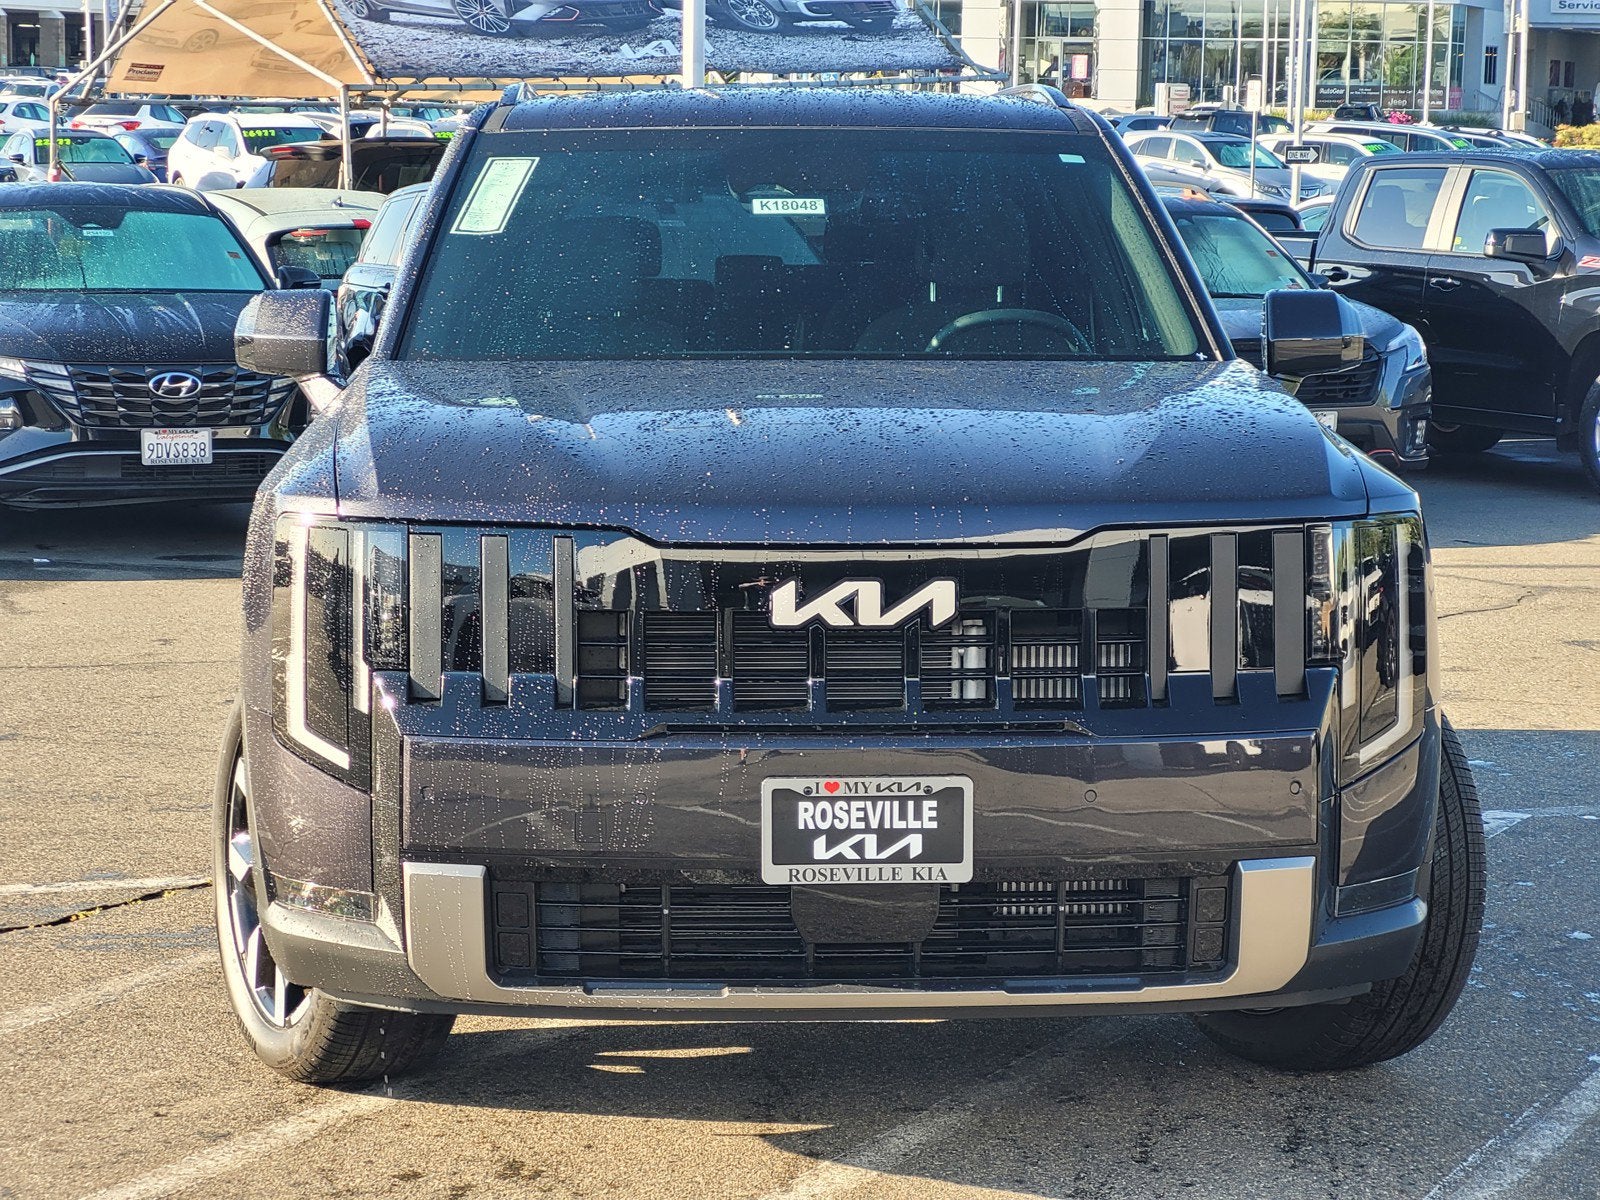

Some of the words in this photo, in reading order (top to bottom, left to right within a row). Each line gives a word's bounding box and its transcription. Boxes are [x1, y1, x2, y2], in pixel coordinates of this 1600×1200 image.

[1387, 97, 1408, 107] Jeep
[35, 138, 71, 147] 2277
[1288, 151, 1299, 159] ONE
[1299, 151, 1310, 159] WAY
[759, 200, 819, 211] K18048
[147, 442, 207, 459] 9DVS838
[771, 579, 957, 628] KIA
[814, 782, 820, 795] I
[843, 781, 873, 795] MY
[875, 781, 922, 793] KIA
[798, 800, 938, 830] ROSEVILLE
[813, 833, 923, 860] KIA
[788, 866, 902, 883] ROSEVILLE
[911, 866, 948, 882] KIA
